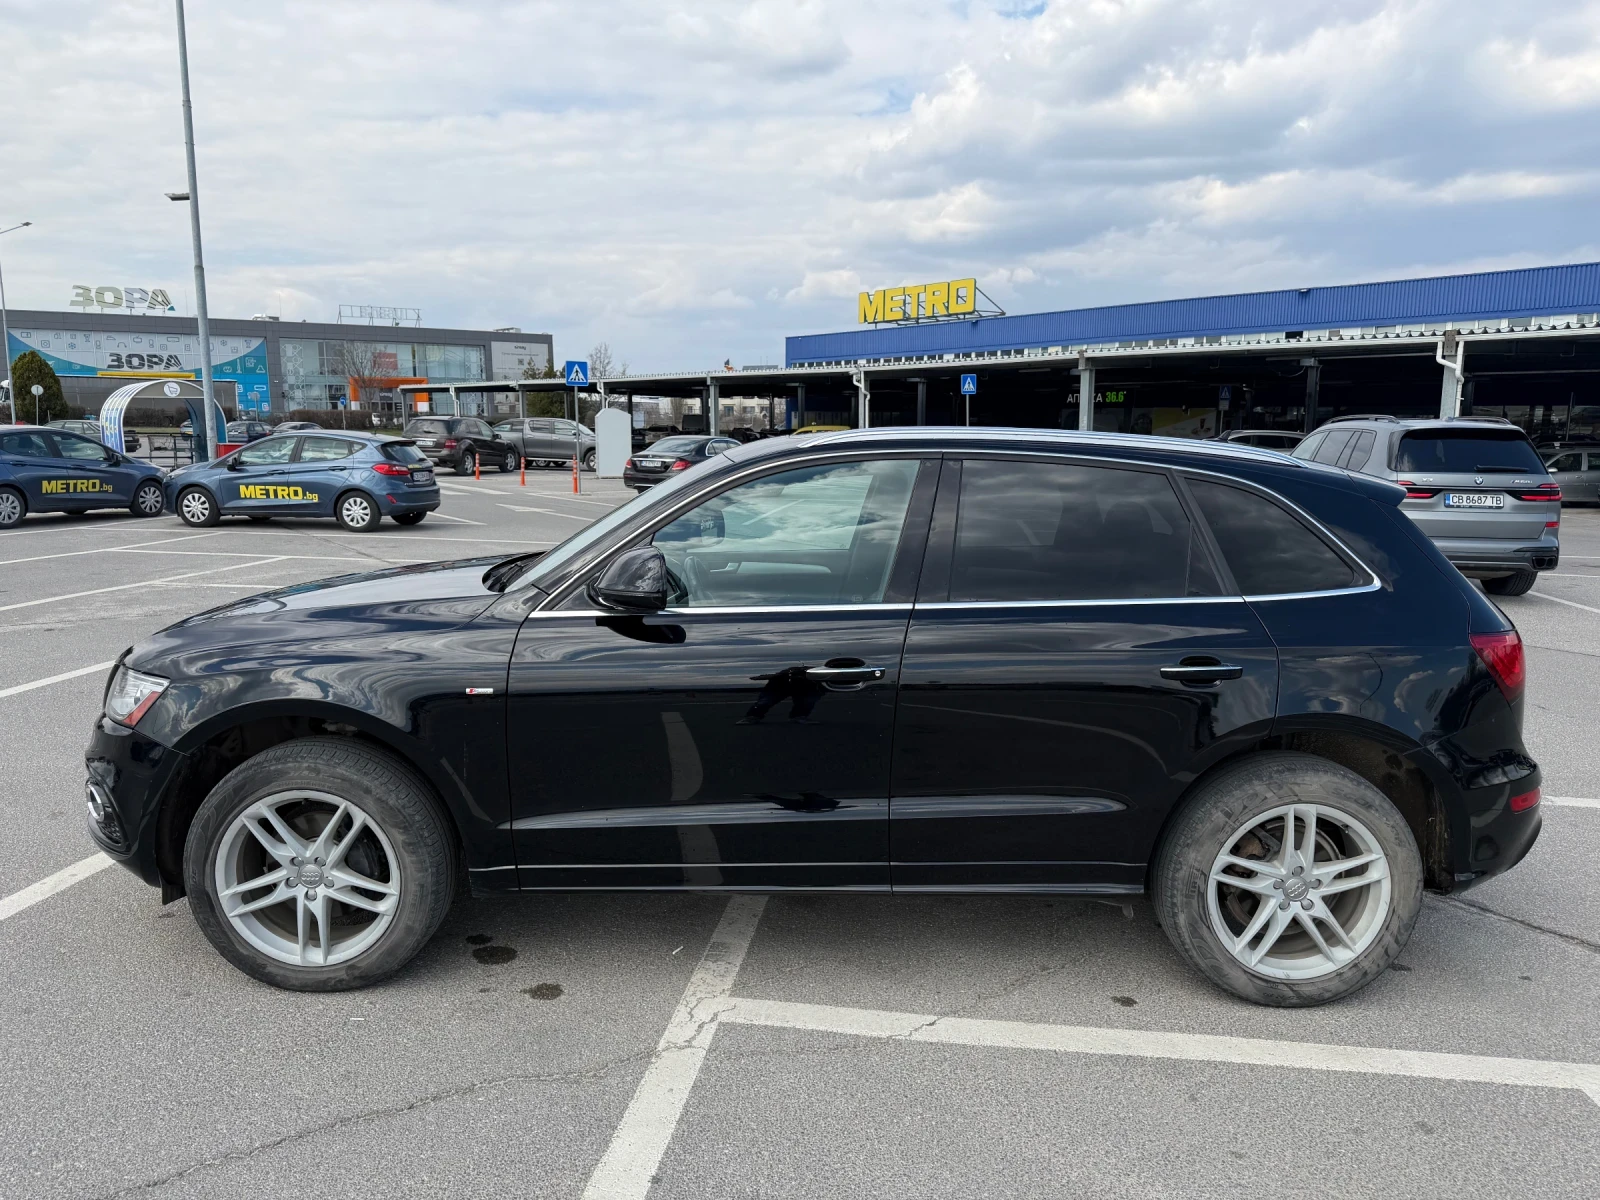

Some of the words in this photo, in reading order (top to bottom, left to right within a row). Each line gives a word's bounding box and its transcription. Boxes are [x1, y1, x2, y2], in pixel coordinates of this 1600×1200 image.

[69, 285, 175, 311] ЗОРА
[858, 278, 976, 324] METRO
[106, 352, 185, 371] ЗОРА
[41, 479, 113, 494] METRO.bg
[239, 484, 319, 502] METRO.bg
[1465, 495, 1488, 505] 8687
